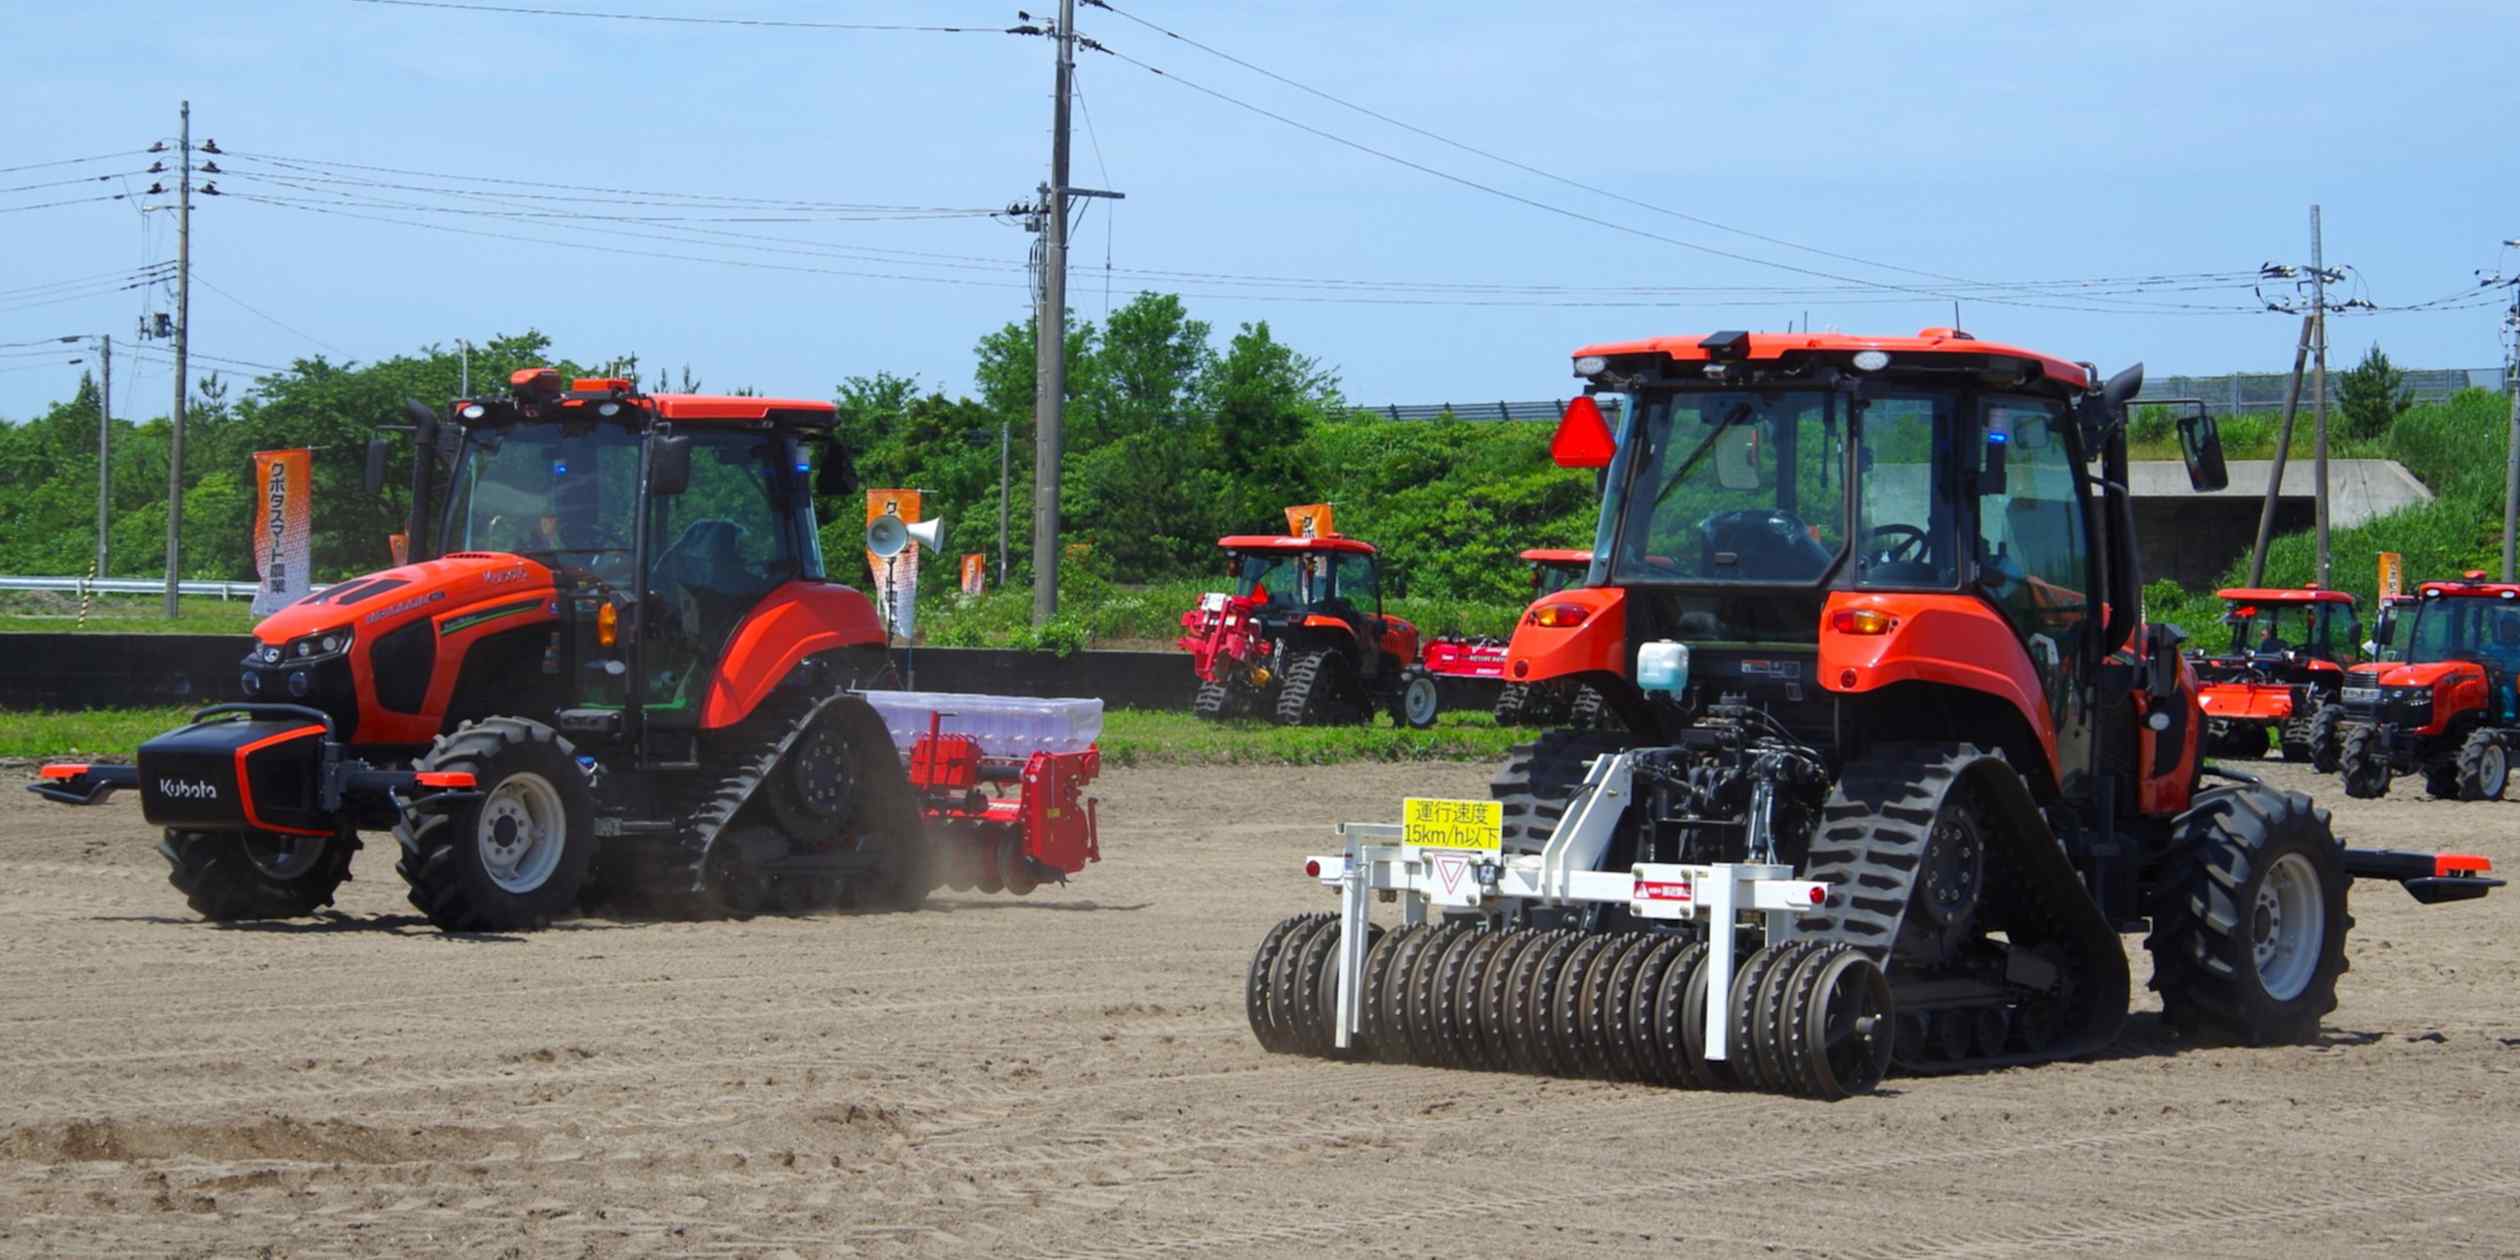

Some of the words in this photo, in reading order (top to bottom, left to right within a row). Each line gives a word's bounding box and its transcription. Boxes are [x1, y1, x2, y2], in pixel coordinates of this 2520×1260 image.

[270, 463, 286, 593] クボタスマート農業
[160, 779, 217, 798] Kubota
[1415, 800, 1489, 825] 運行速度
[1404, 823, 1500, 848] 15km/h以下
